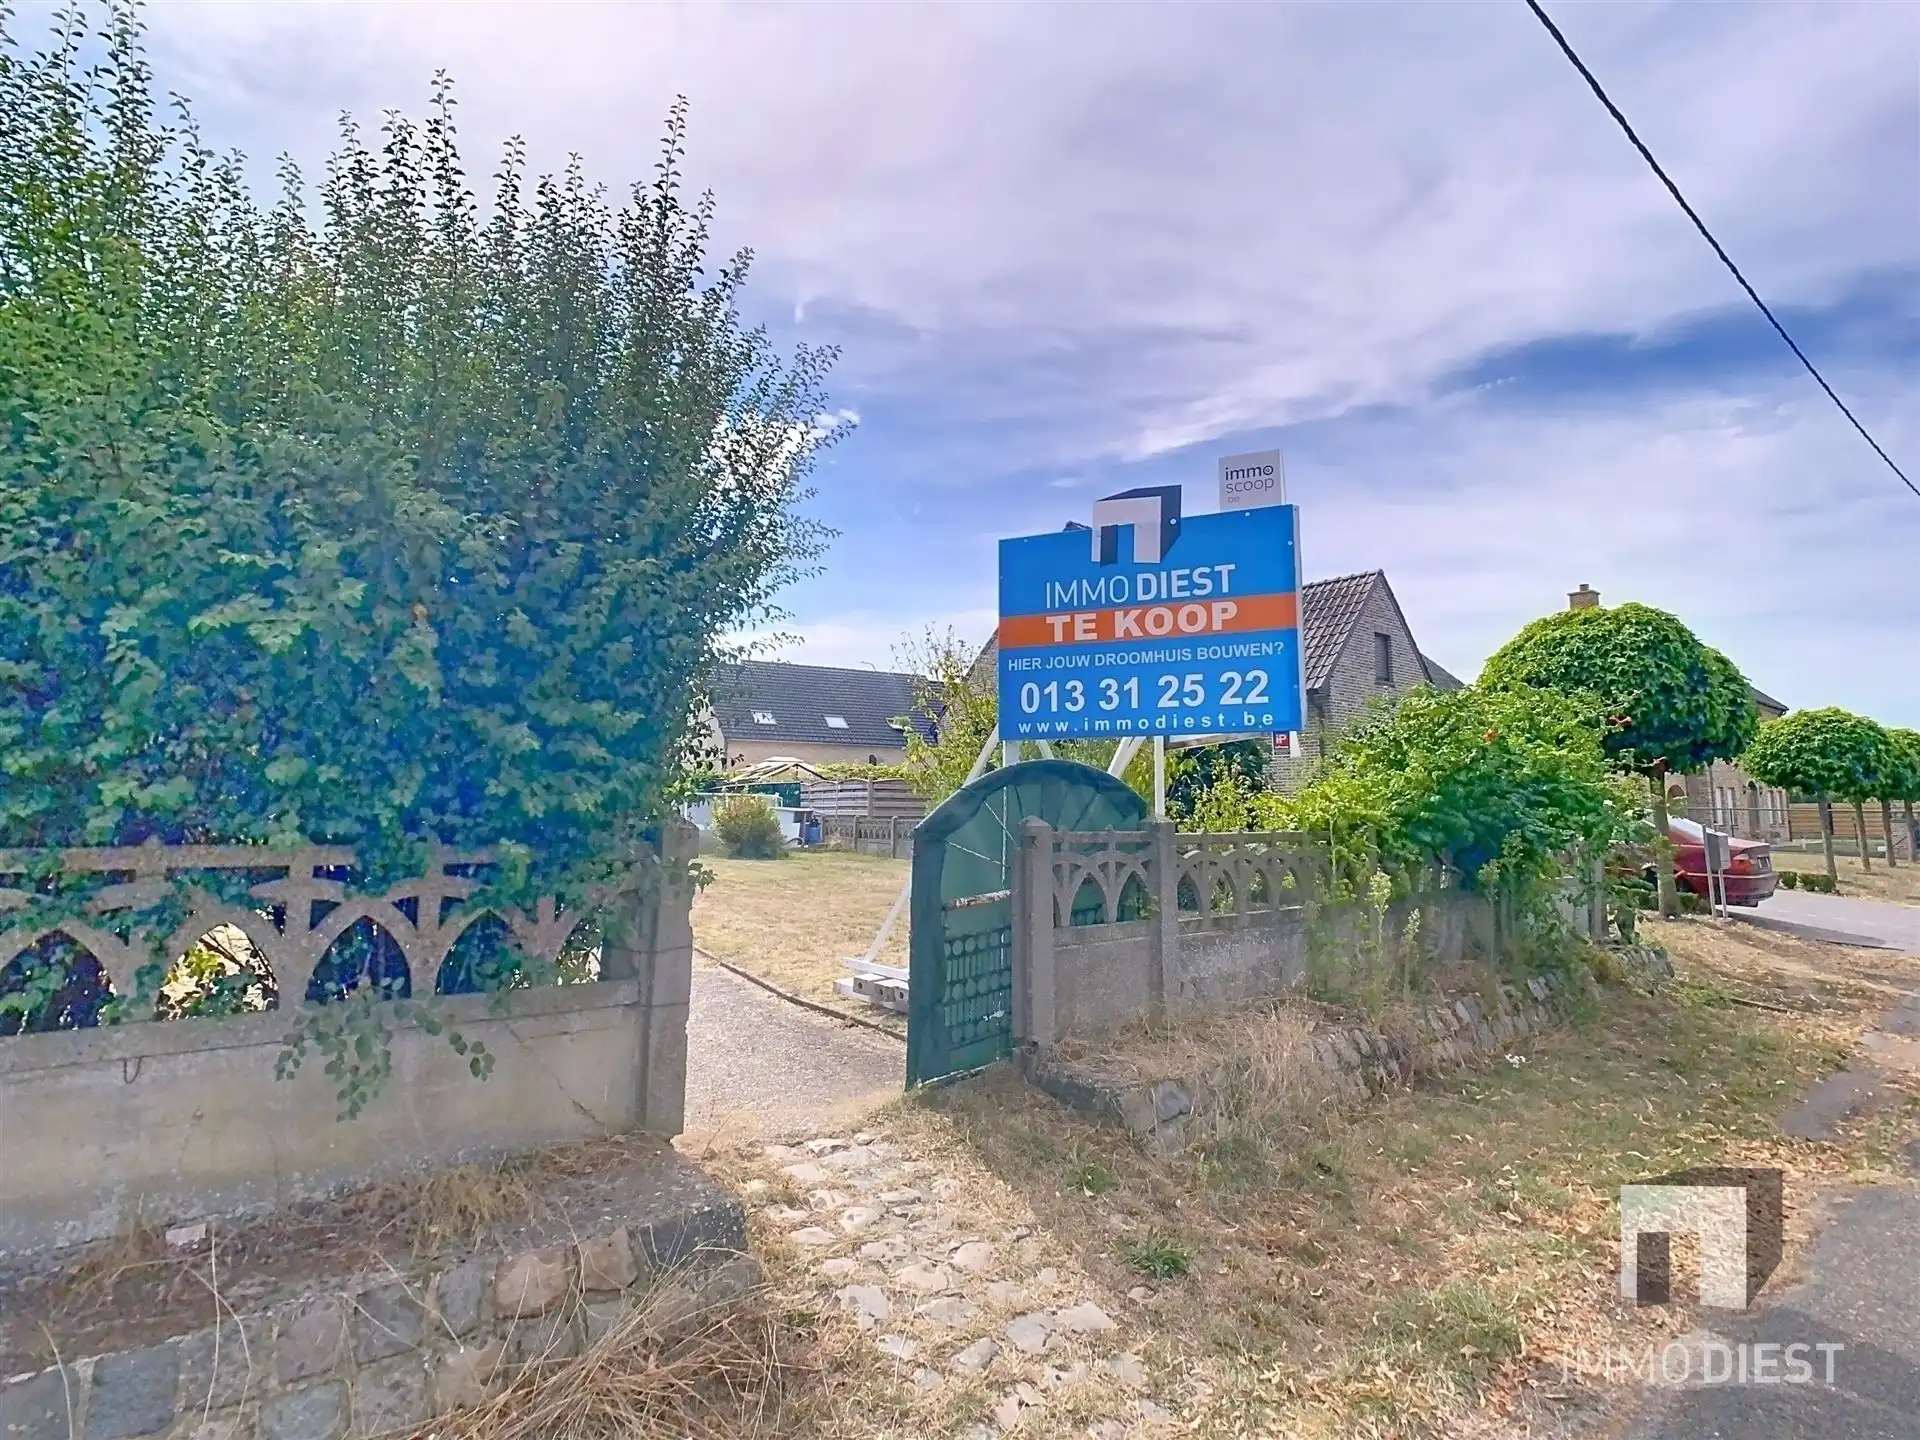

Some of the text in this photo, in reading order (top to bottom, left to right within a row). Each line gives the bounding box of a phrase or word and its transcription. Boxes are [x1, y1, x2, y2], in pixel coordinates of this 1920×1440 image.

[1225, 465, 1274, 480] immo
[1225, 478, 1274, 493] scoop
[1045, 564, 1236, 609] IMMO DIEST
[1045, 601, 1238, 643] TE KOOP
[1008, 641, 1284, 671] HIER JOUW DROOMHUIS BOUWEN?
[1020, 670, 1270, 714] 013 31 25 22
[1018, 711, 1274, 733] www.immodiest.be
